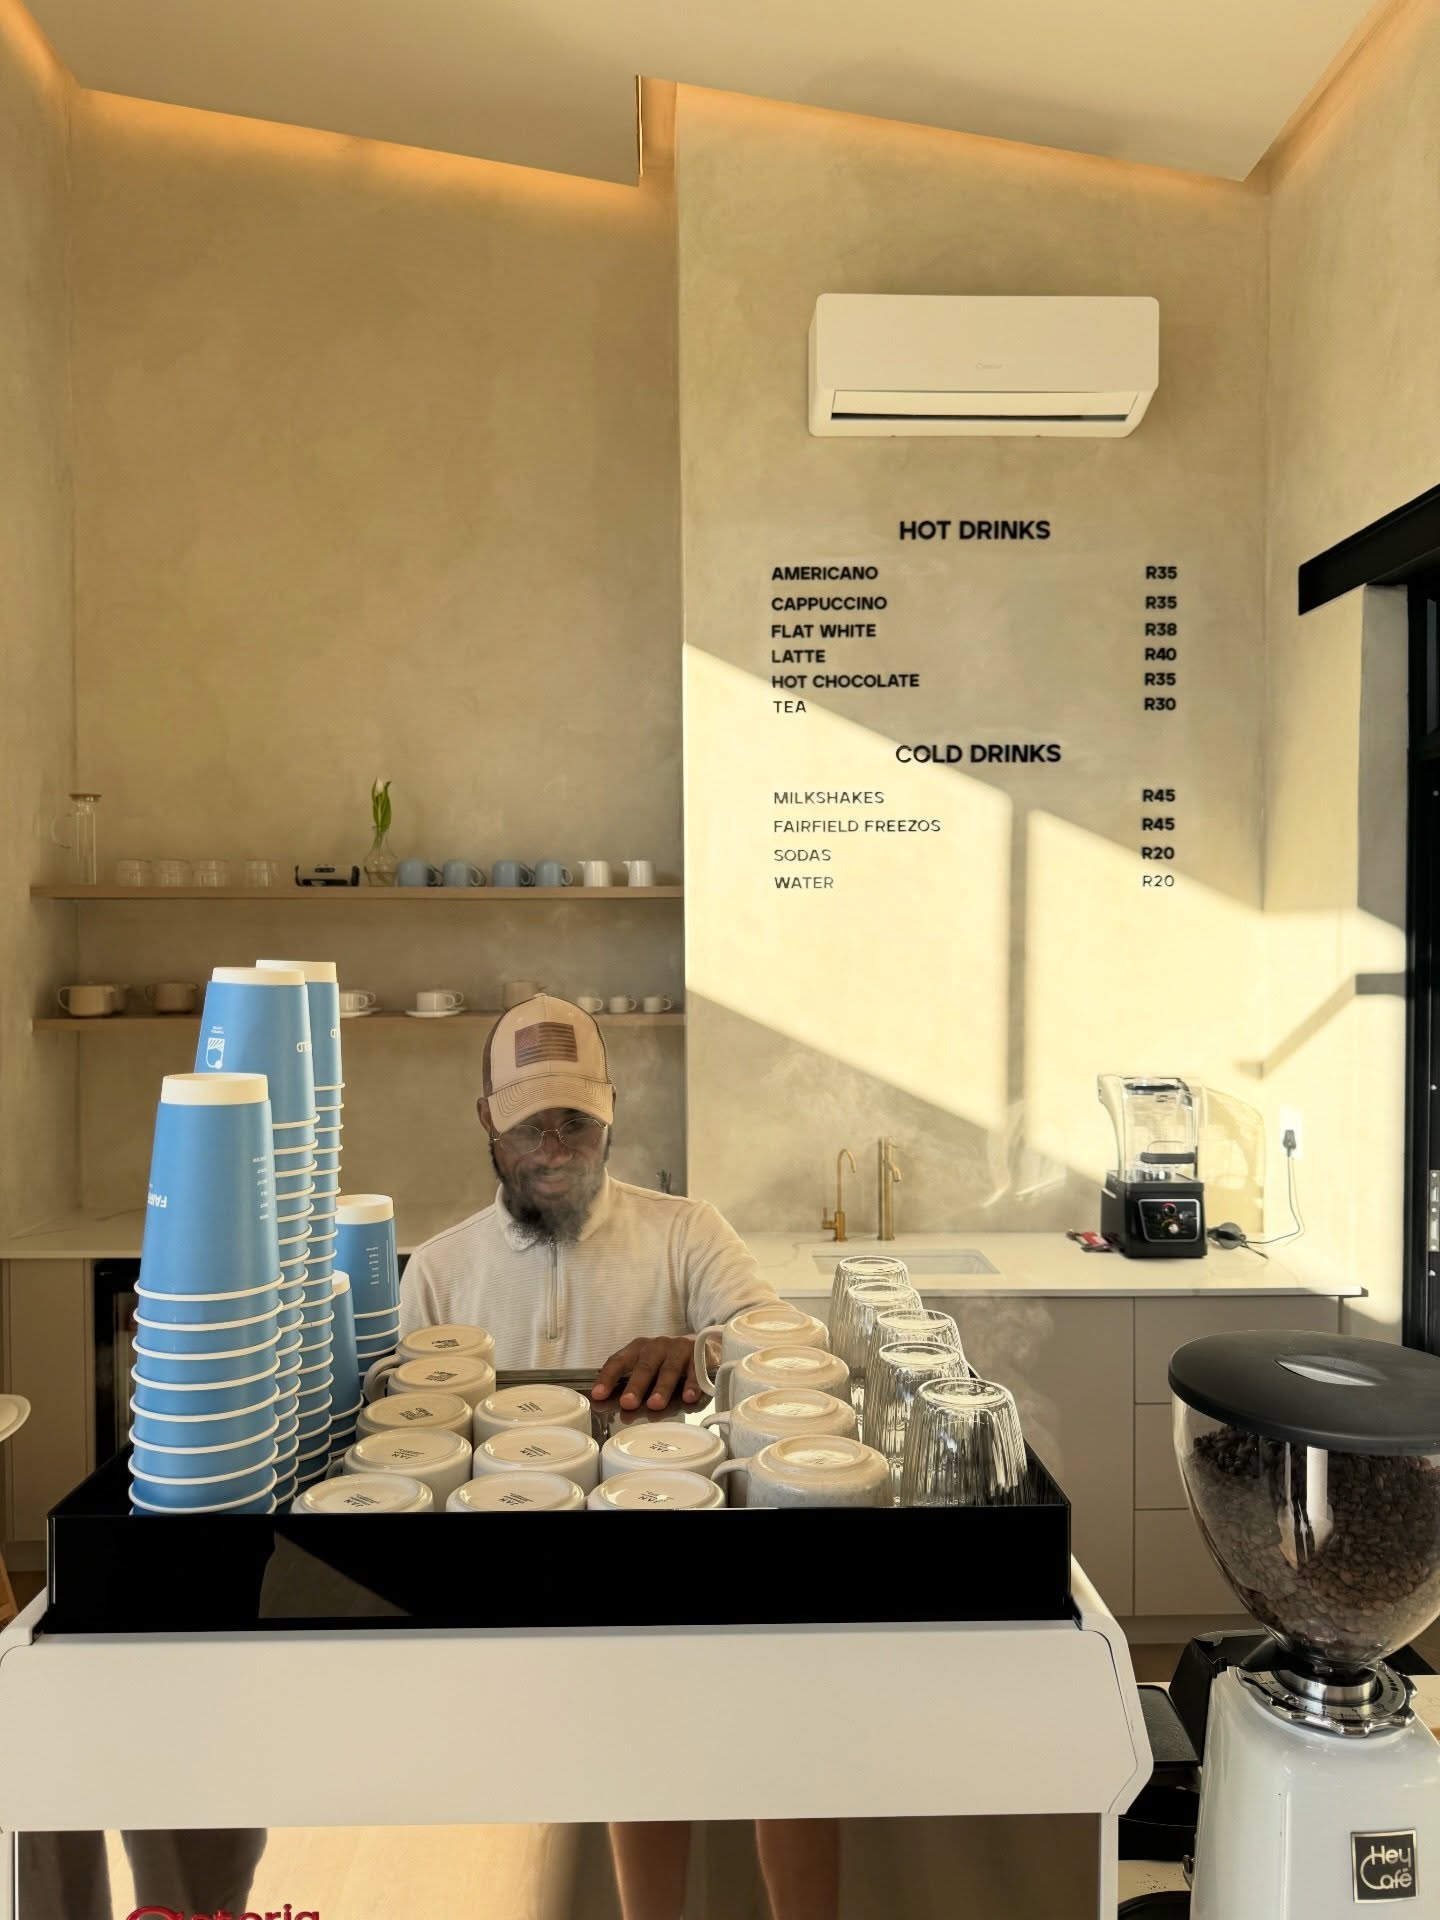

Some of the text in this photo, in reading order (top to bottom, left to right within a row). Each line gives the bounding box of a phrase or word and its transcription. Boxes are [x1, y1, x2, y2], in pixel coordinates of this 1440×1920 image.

[899, 519, 1051, 540] HOT DRINKS
[771, 565, 1178, 581] AMERICANO R35
[771, 595, 1178, 611] CAPPUCCINO R35
[771, 622, 1178, 639] FLAT WHITE R38
[771, 647, 1178, 664] LATTE R40
[771, 671, 1177, 689] HOT CHOCOLATE R35
[773, 696, 1177, 714] TEA R30
[895, 744, 1062, 763] COLD DRINKS
[773, 788, 1176, 805] MILKSHAKES R45
[773, 816, 1176, 833] FAIRFIELD FREEZOS R45
[773, 845, 1175, 862] SODAS R20
[774, 874, 1175, 889] WATER R20
[1370, 1845, 1412, 1868] Hey
